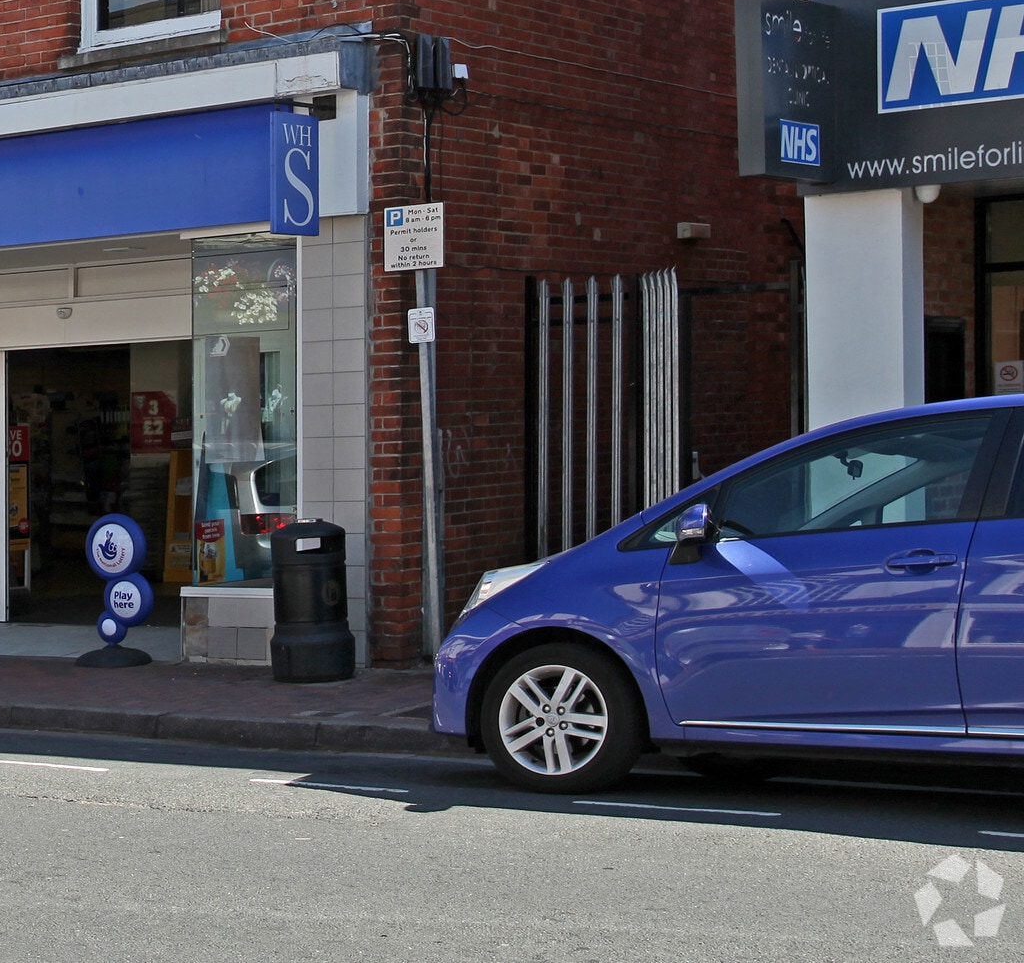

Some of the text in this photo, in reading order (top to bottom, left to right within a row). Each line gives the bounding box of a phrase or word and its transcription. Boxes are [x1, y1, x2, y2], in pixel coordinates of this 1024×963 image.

[282, 123, 312, 147] WH
[781, 124, 818, 162] NHS
[847, 141, 1024, 179] www.smileforli
[284, 147, 314, 227] S
[390, 211, 401, 226] P
[148, 399, 159, 415] 3
[10, 430, 22, 440] VE
[143, 420, 164, 436] £2
[99, 557, 117, 568] National
[117, 547, 126, 567] Lottery
[114, 591, 133, 601] Play
[113, 600, 134, 609] here
